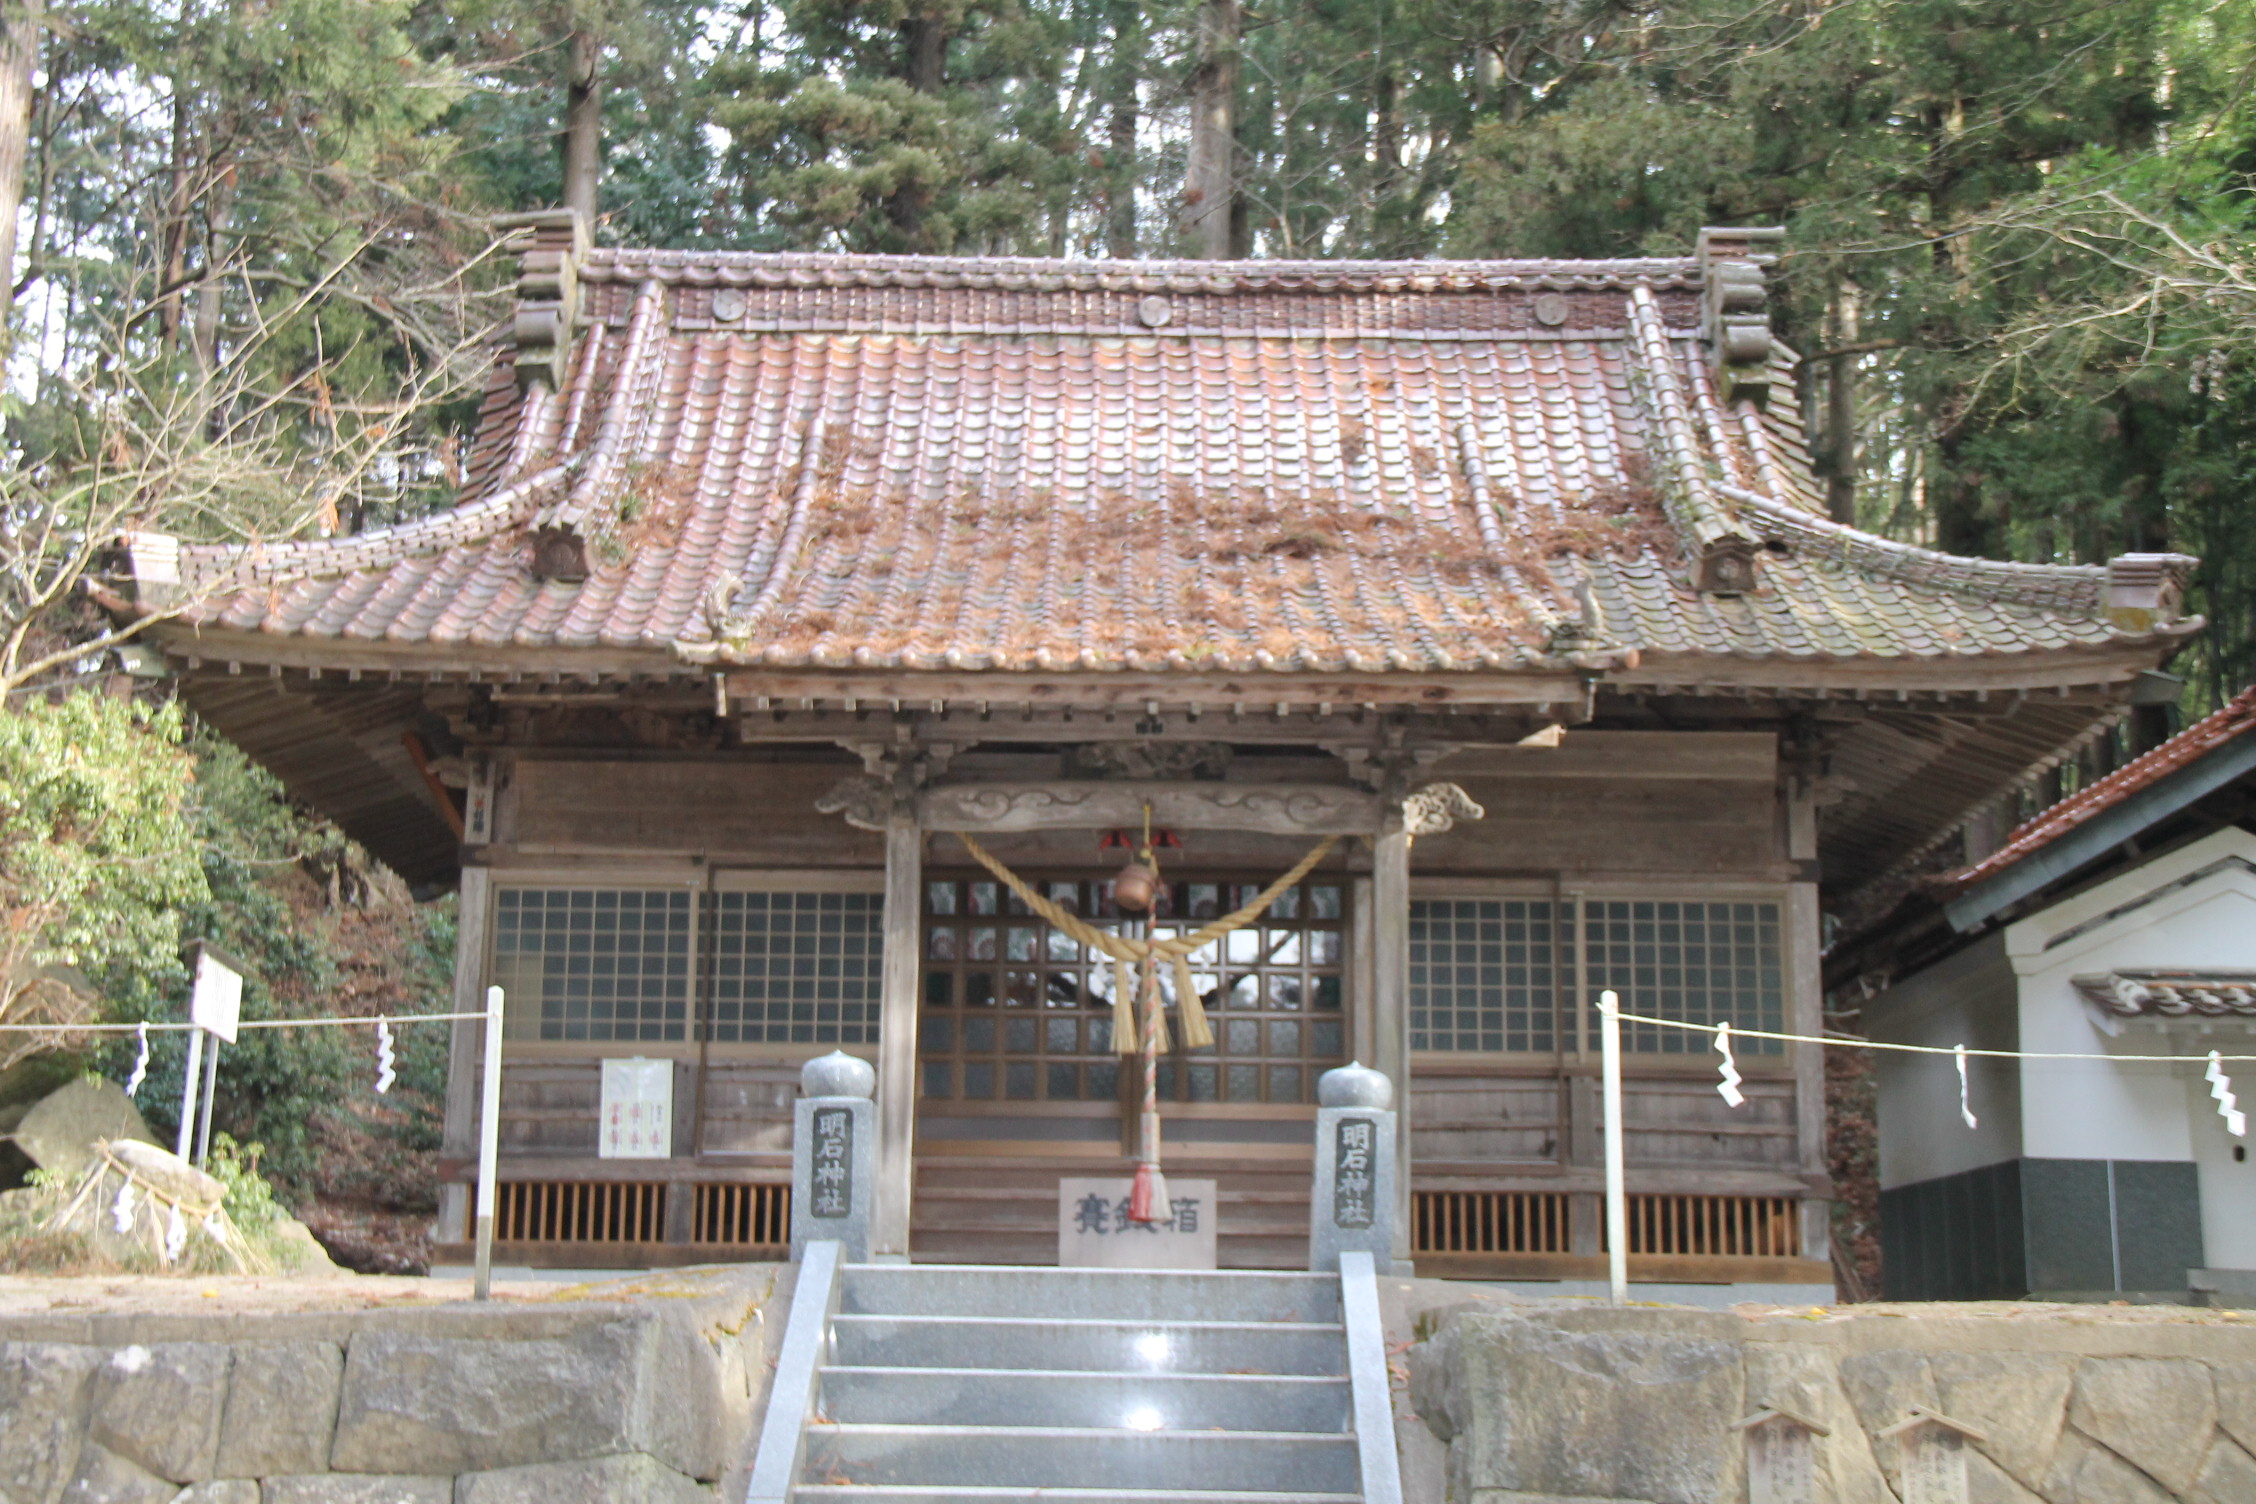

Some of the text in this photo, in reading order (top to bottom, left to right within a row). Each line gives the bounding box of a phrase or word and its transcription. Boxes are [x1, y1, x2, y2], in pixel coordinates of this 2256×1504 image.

[815, 1112, 848, 1214] 明石神社
[1337, 1123, 1370, 1223] 明石神社
